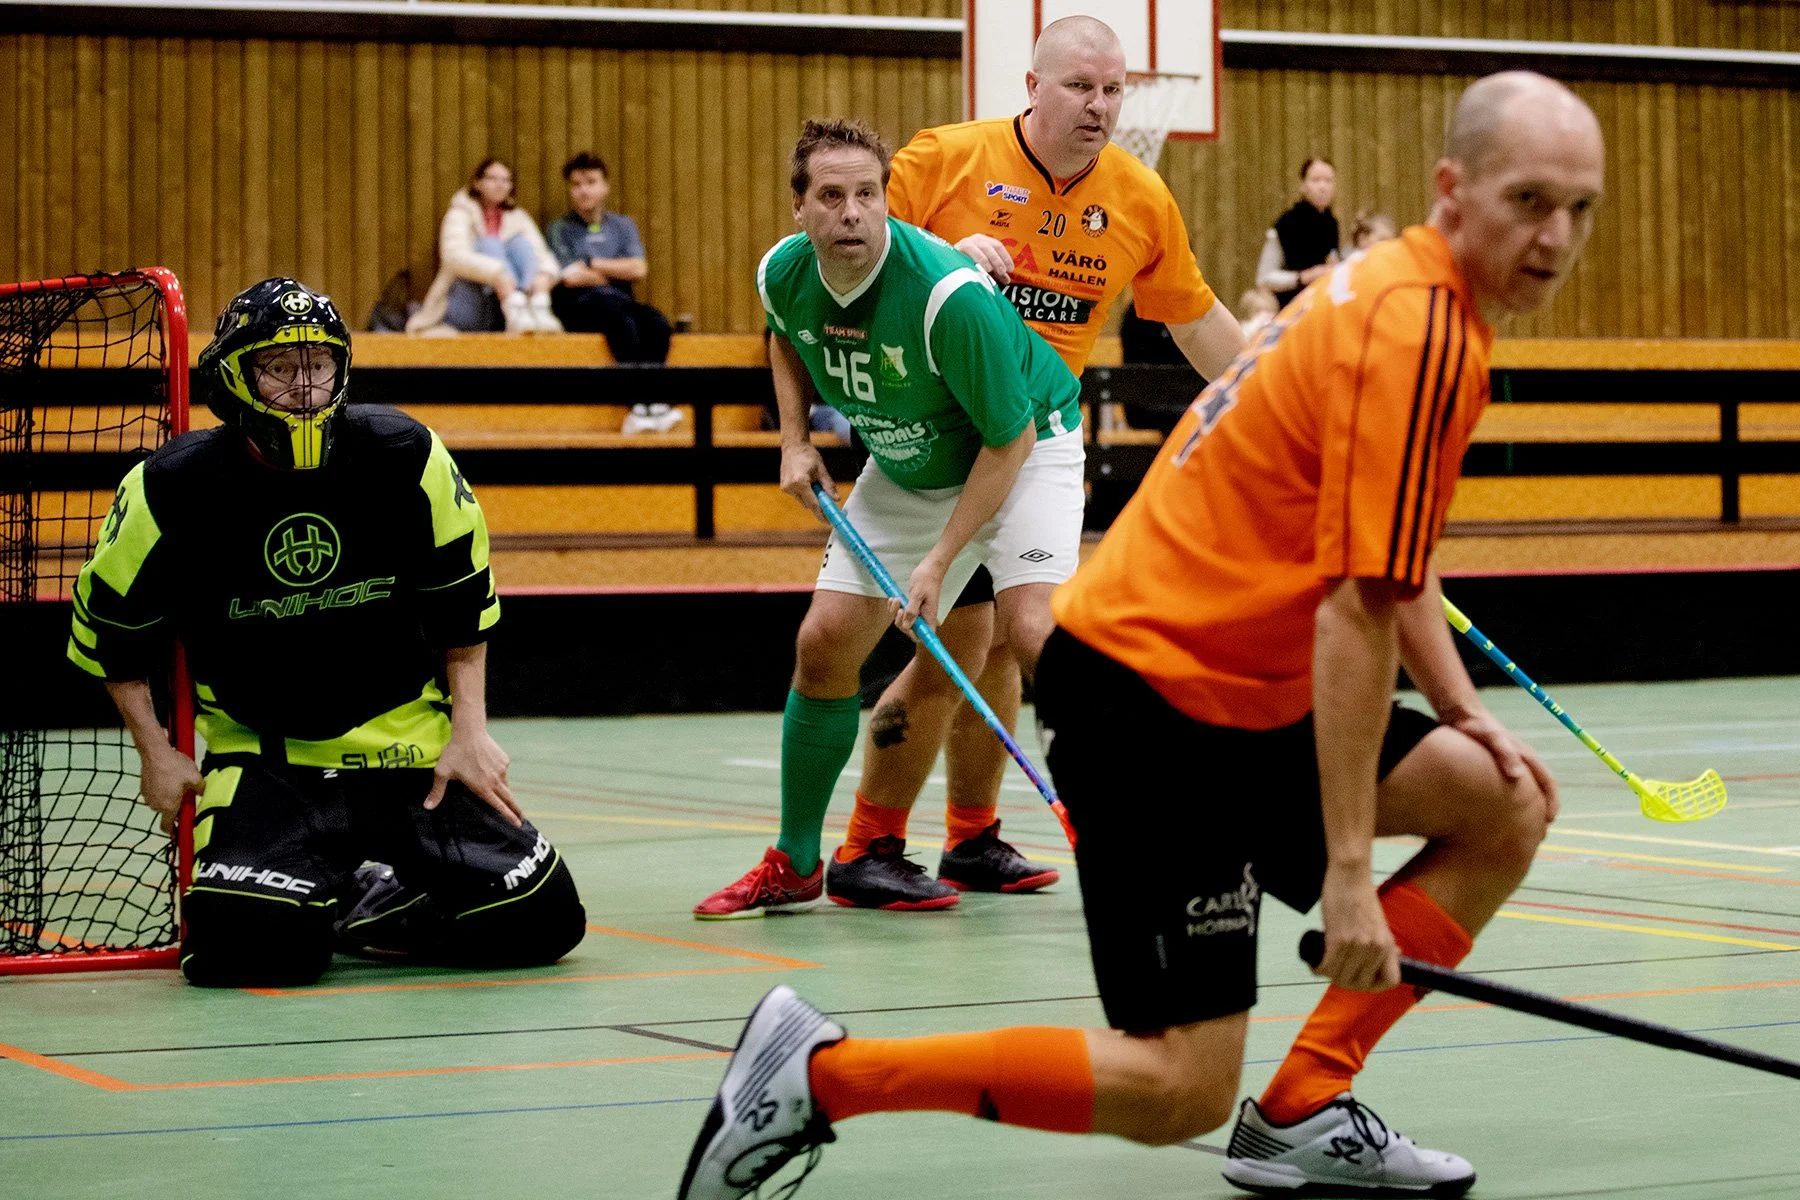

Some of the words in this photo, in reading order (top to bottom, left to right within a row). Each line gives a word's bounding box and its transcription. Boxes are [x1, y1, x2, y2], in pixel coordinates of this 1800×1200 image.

[1003, 192, 1028, 203] SPORT
[1037, 209, 1068, 238] 20
[1052, 250, 1107, 271] VÄRÖ
[1048, 268, 1107, 286] HALLEN
[823, 346, 877, 403] 46
[229, 576, 396, 619] UNIHOC
[197, 862, 316, 894] UNIHOC
